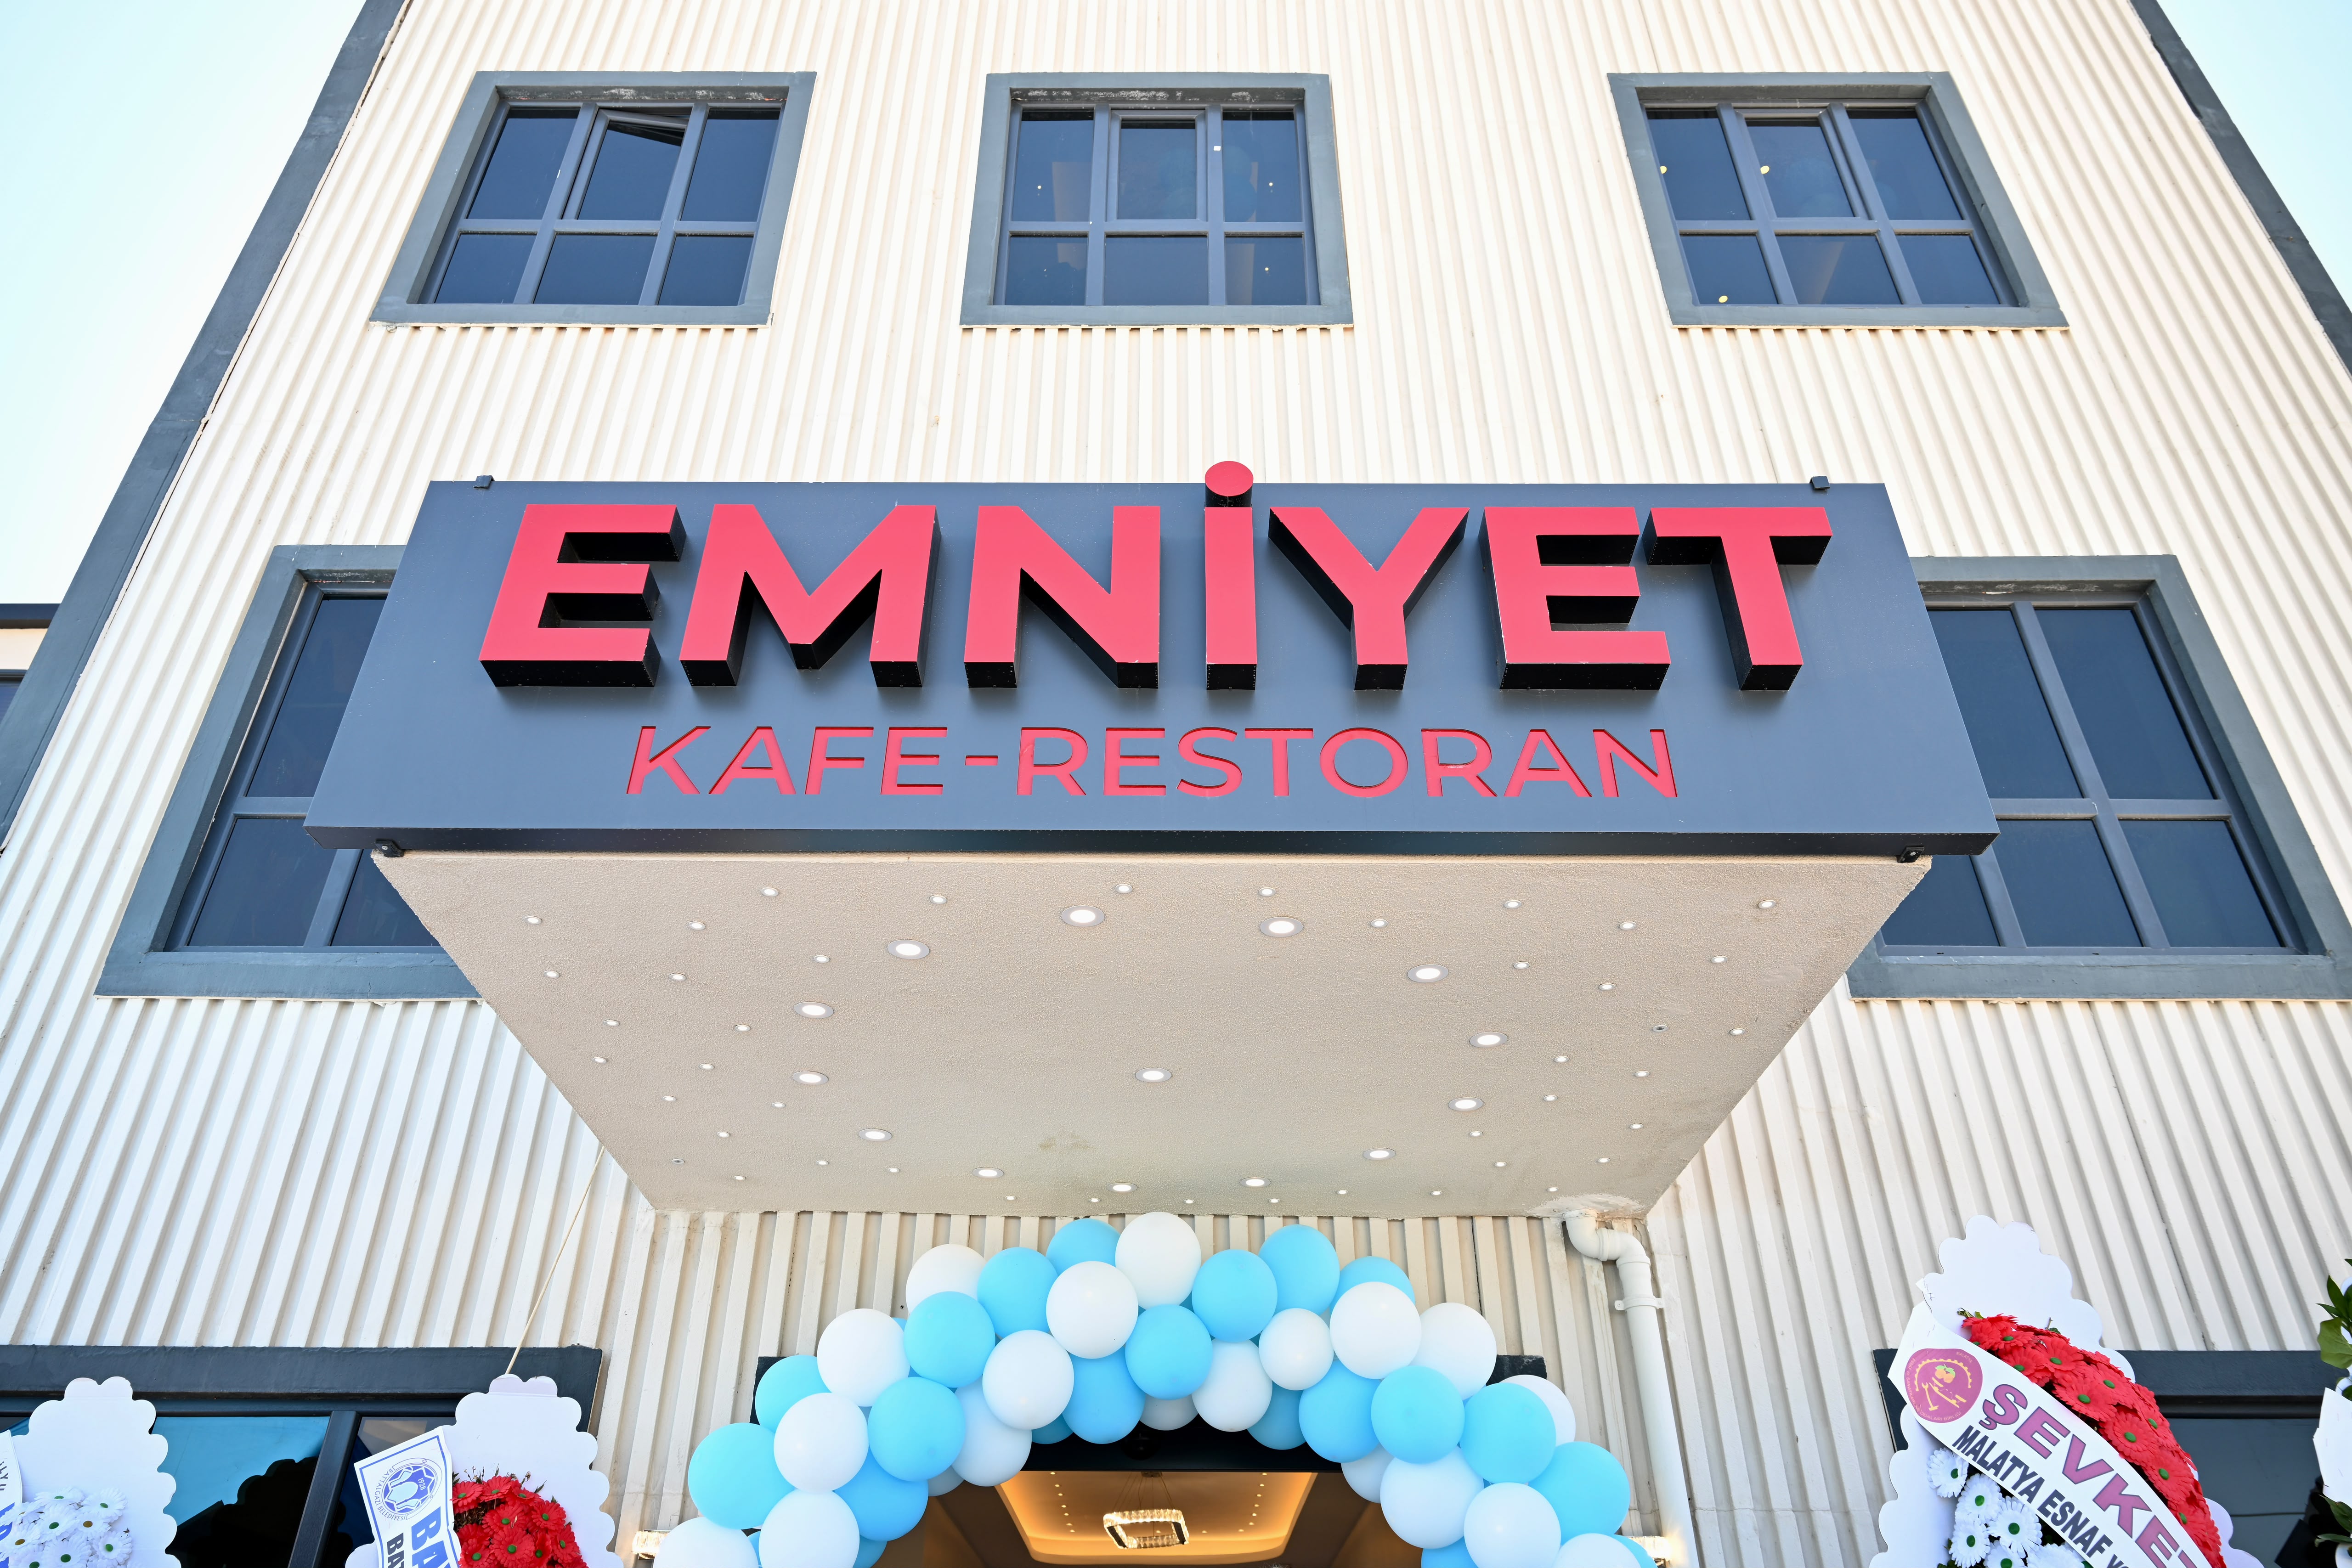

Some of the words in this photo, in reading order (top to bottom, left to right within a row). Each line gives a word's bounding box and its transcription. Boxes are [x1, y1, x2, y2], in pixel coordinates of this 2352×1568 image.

[479, 461, 1833, 690] EMNİYET
[626, 726, 1678, 798] KAFE-RESTORAN
[374, 1468, 393, 1506] BATTALGAZİ
[418, 1478, 426, 1490] 1928
[1952, 1425, 2045, 1504] MALATYA
[2037, 1489, 2113, 1558] ESNAF
[377, 1506, 406, 1521] BELEDİYESİ
